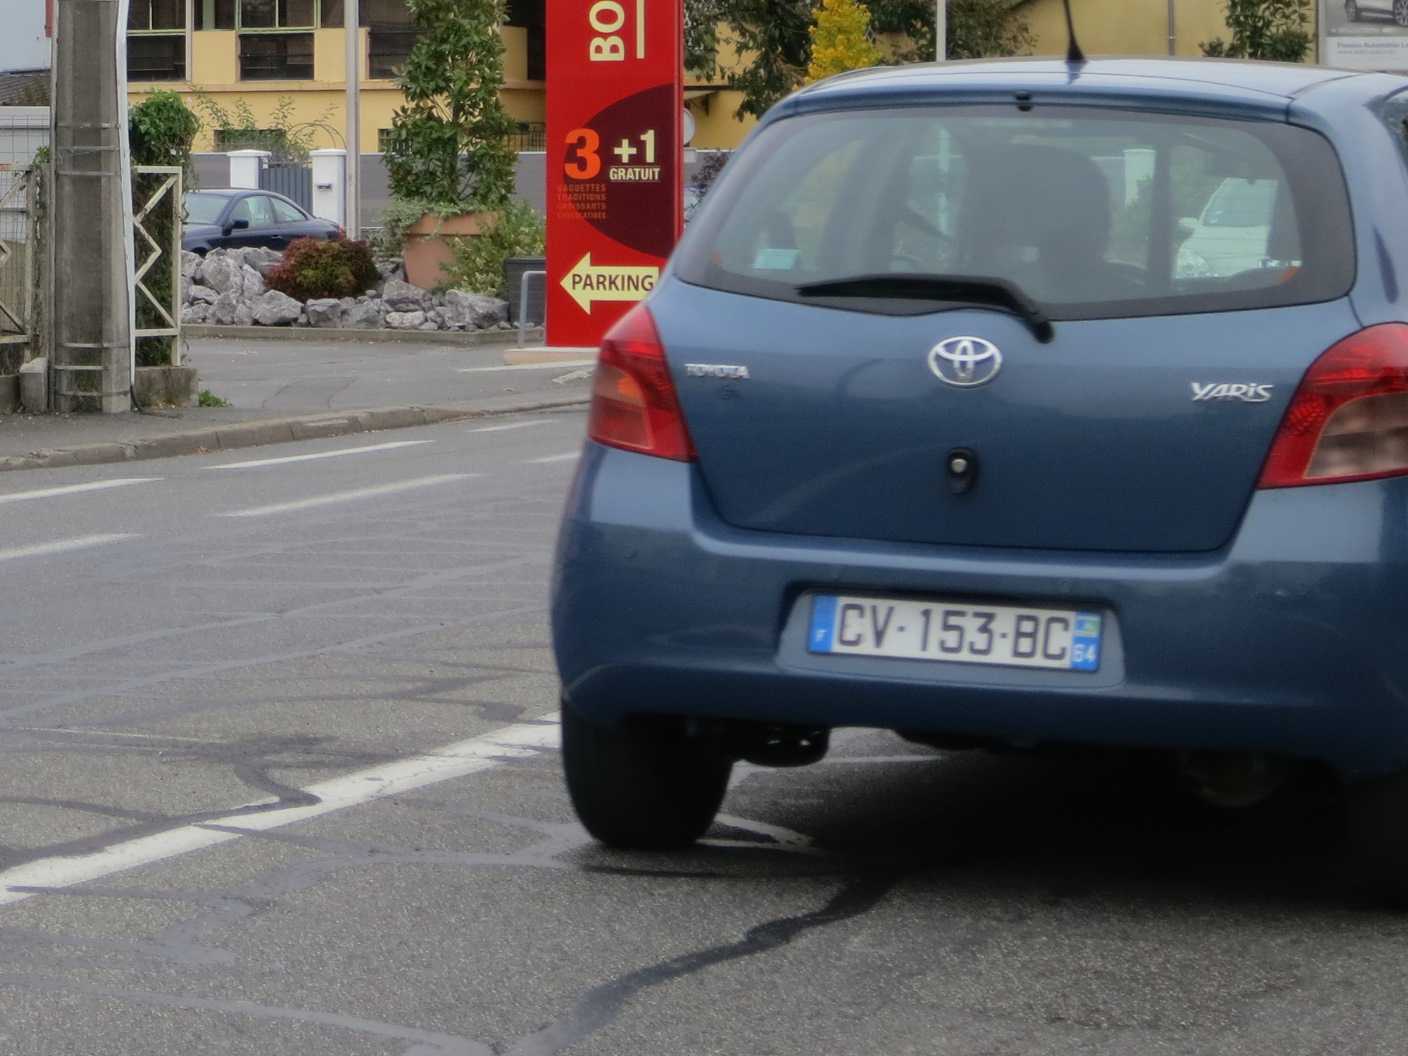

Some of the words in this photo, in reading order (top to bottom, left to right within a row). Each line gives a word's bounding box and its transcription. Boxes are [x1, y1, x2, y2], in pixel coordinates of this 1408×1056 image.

[563, 128, 602, 180] 3
[613, 129, 655, 164] +1
[609, 167, 661, 181] GRATUIT
[571, 273, 655, 292] PARKING
